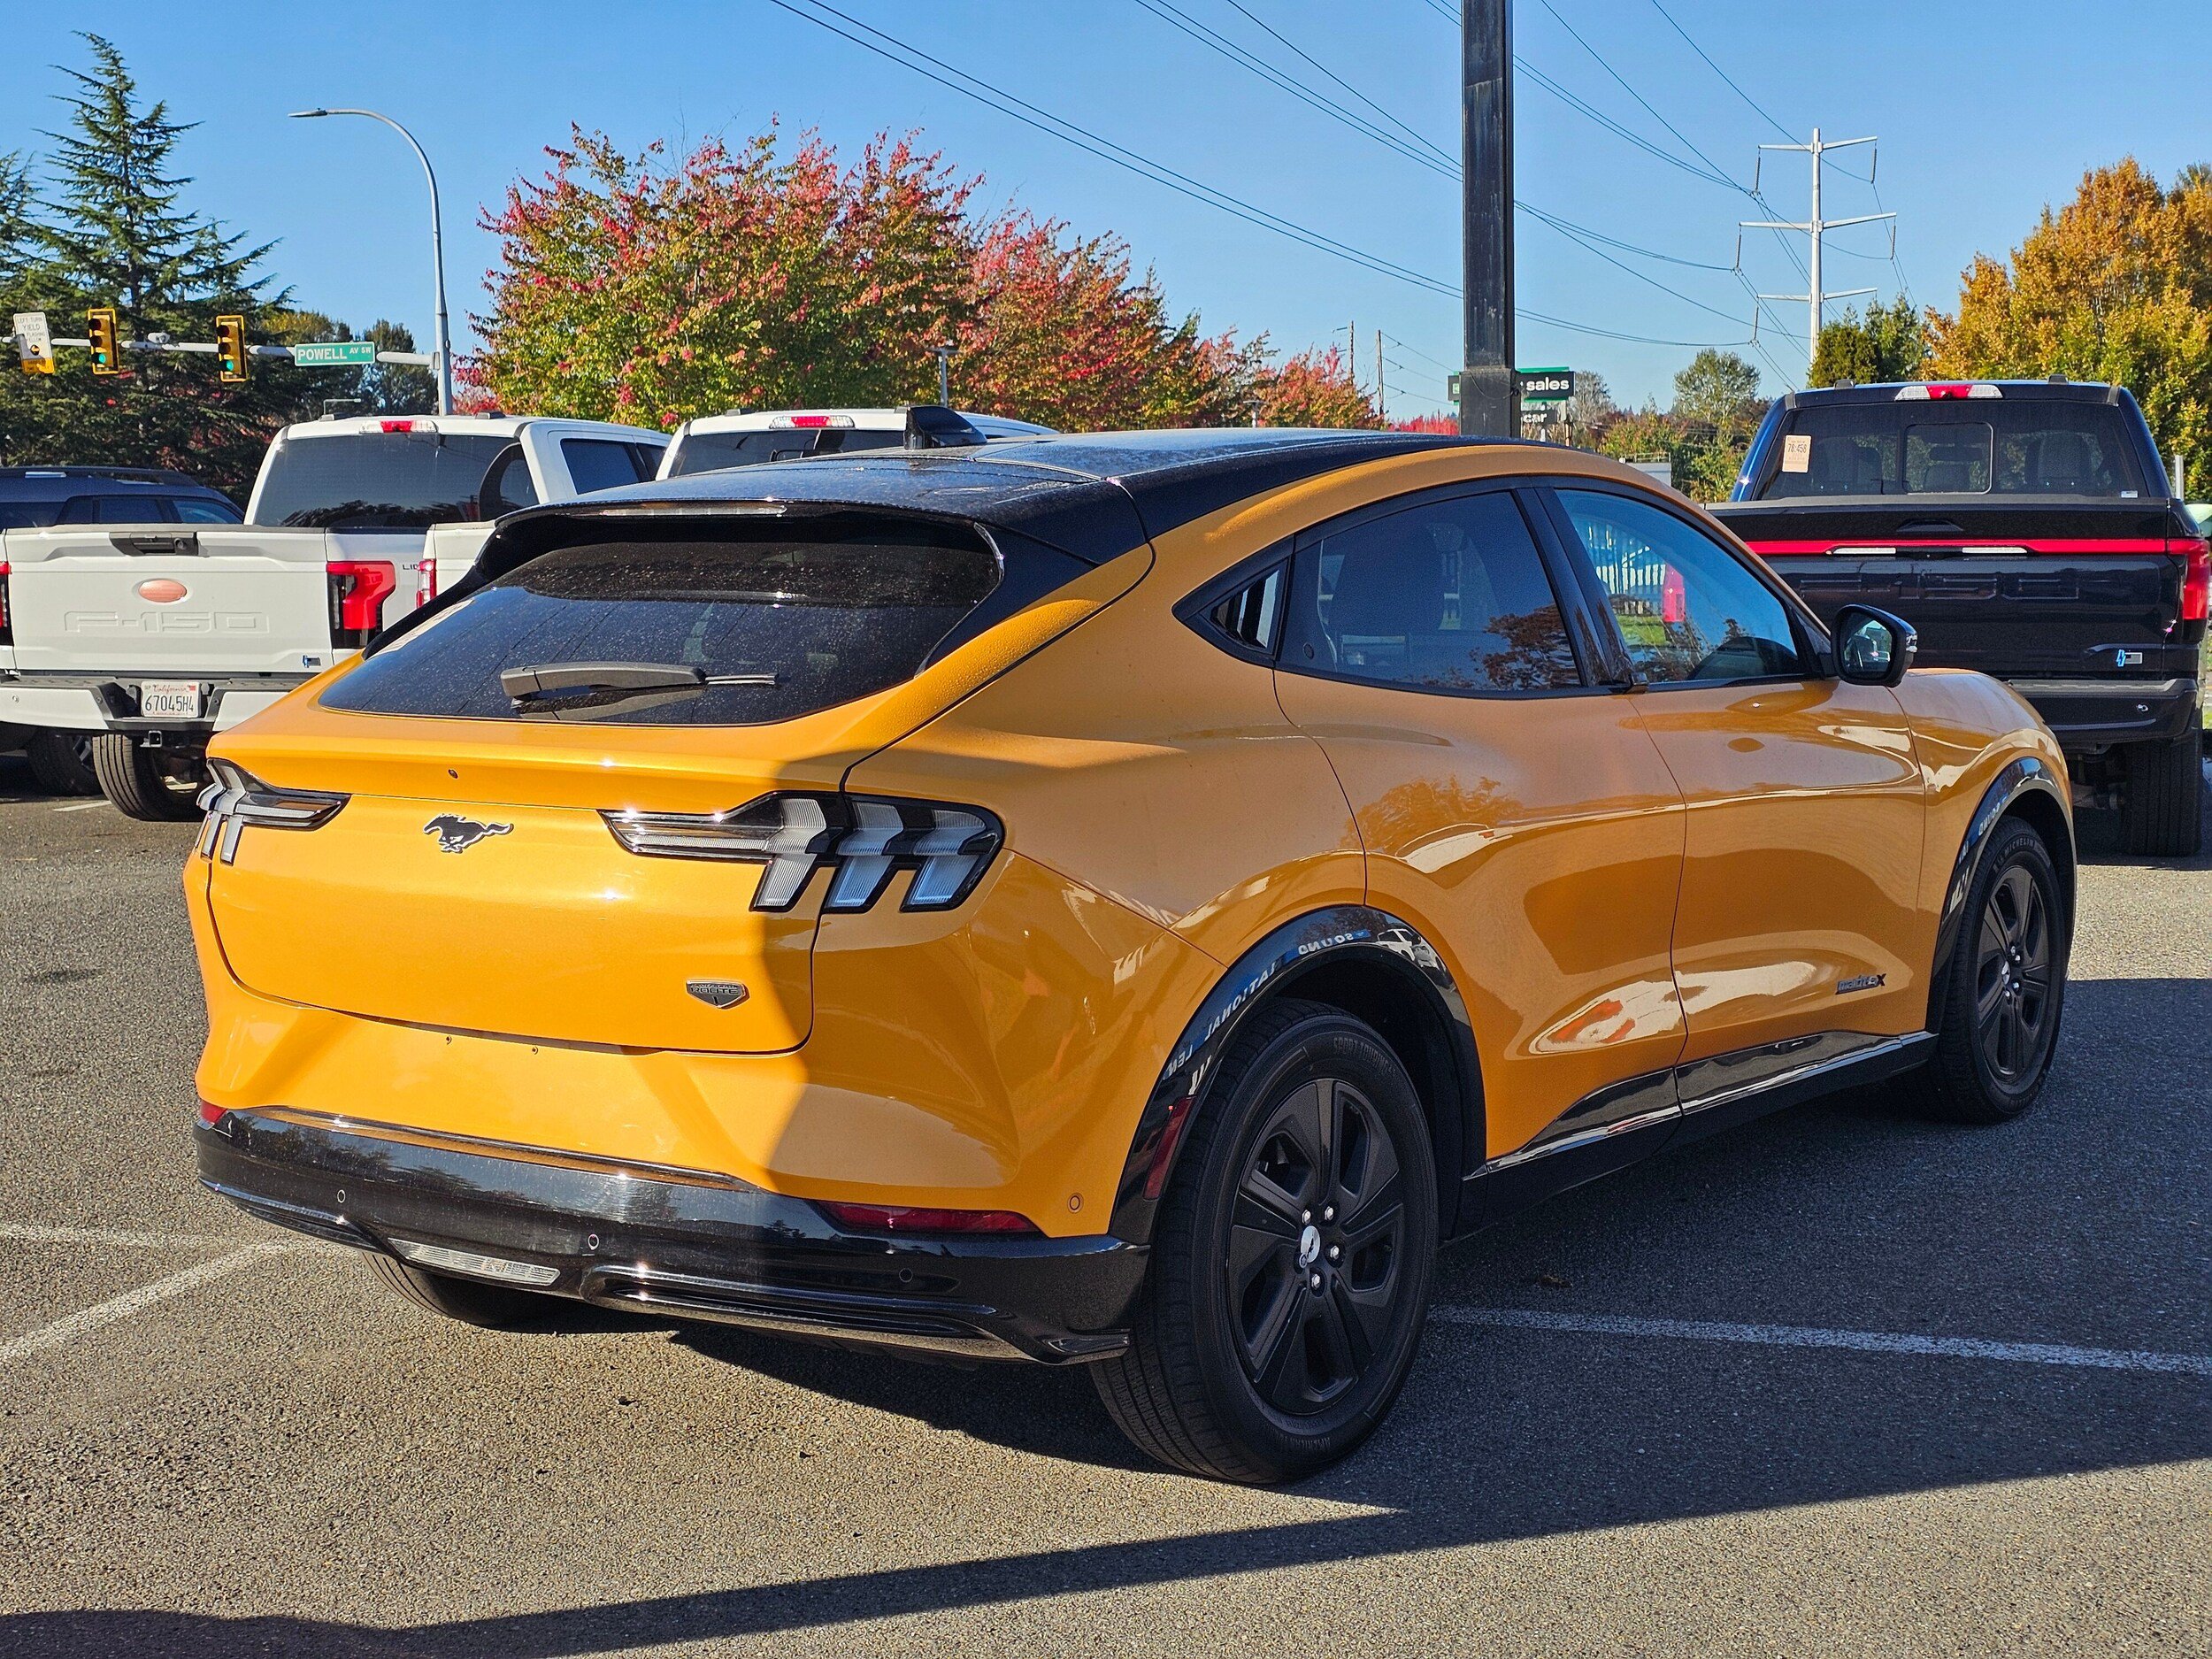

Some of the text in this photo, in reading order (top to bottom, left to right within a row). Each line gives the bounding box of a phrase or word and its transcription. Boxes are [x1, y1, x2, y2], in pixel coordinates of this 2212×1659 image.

[297, 348, 347, 361] POWELL
[1525, 377, 1570, 391] sales
[65, 611, 270, 634] F-150
[145, 695, 194, 711] 67045H4
[2004, 837, 2034, 857] MICHELIN
